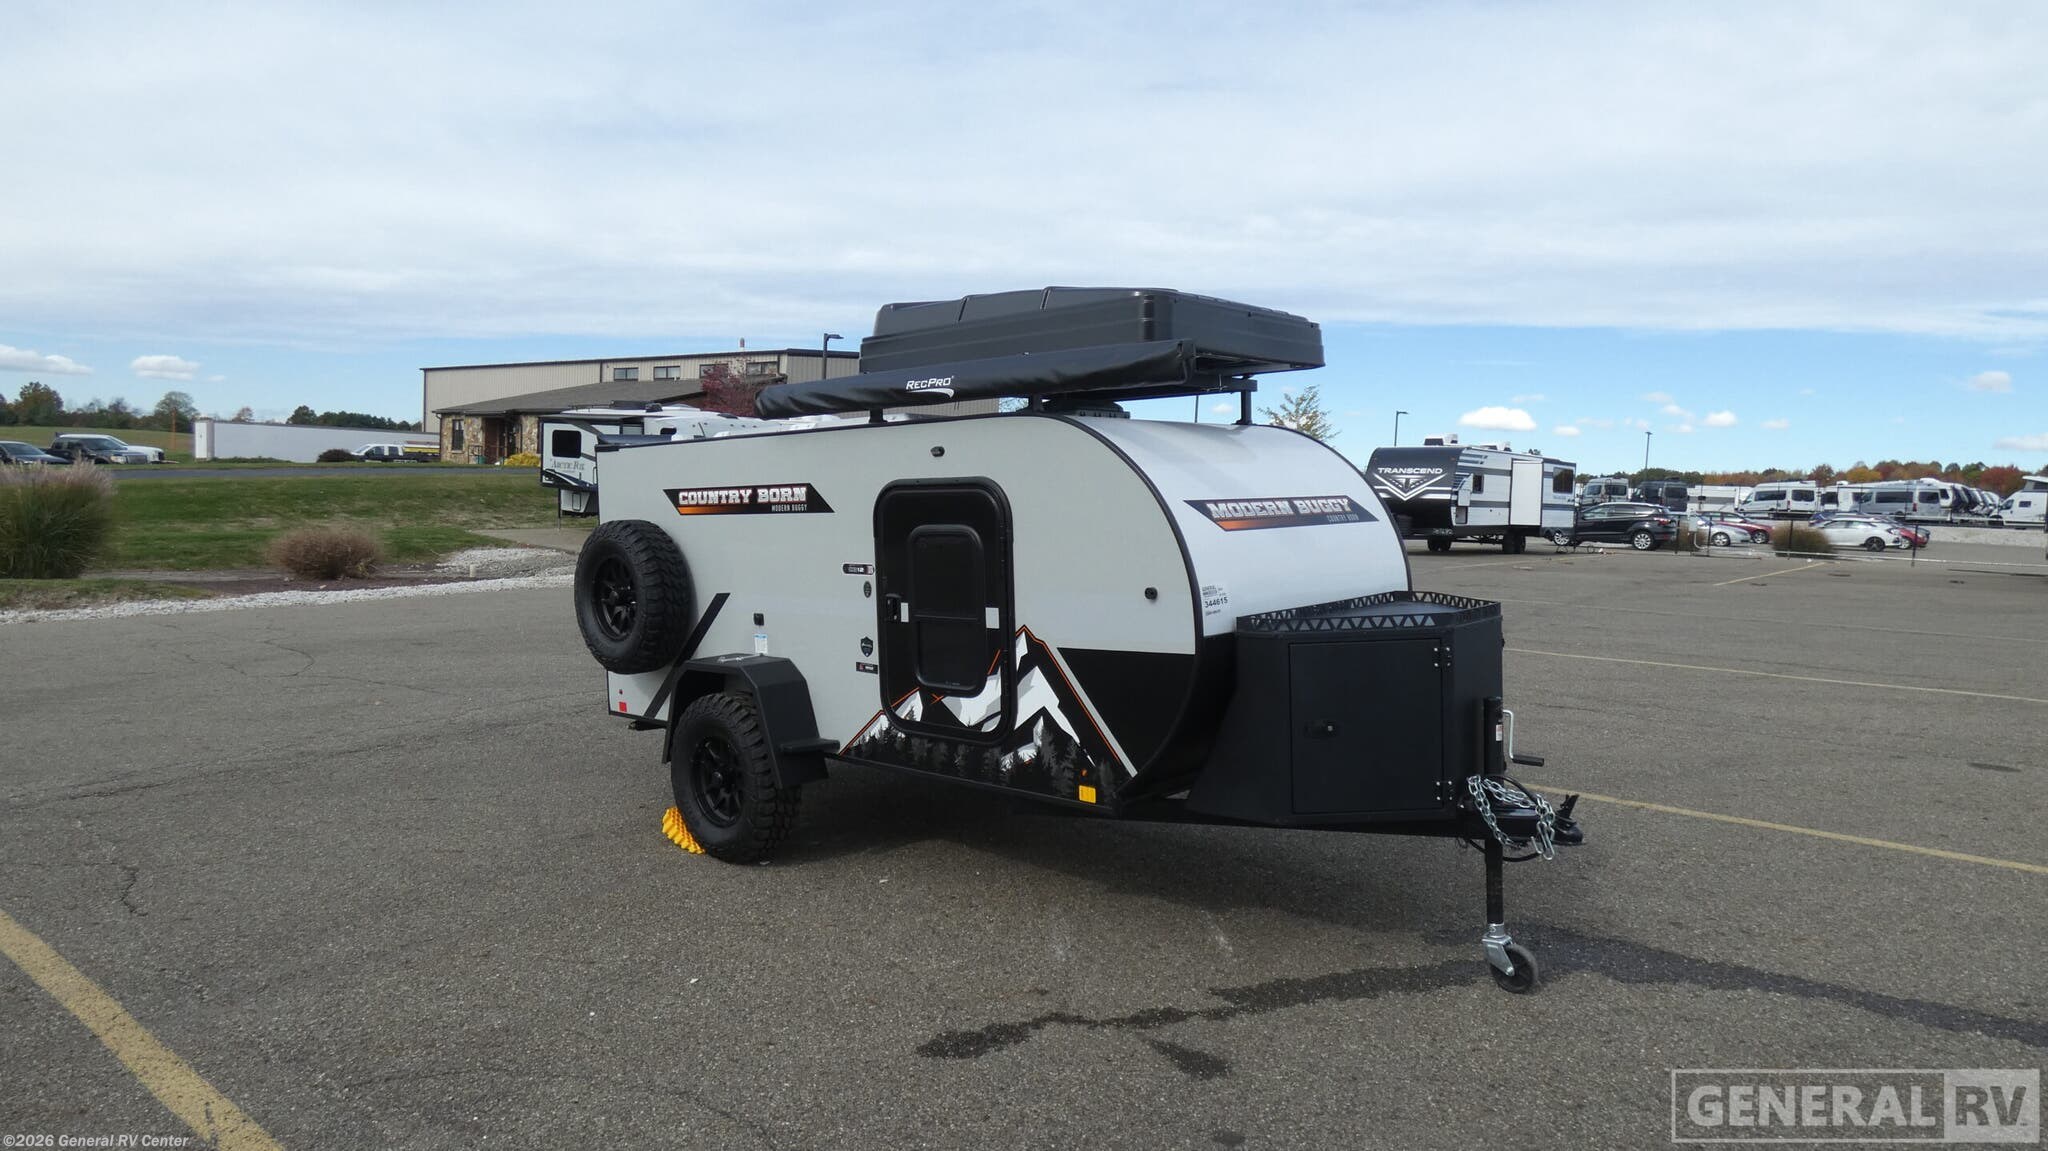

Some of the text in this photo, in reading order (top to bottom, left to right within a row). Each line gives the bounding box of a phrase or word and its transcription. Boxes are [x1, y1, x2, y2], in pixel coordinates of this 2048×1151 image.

[1377, 467, 1443, 475] TRANSCEND
[678, 487, 807, 505] COUNTRY BORN
[771, 504, 791, 513] MODERN
[1206, 498, 1351, 518] MODERN BUGGY
